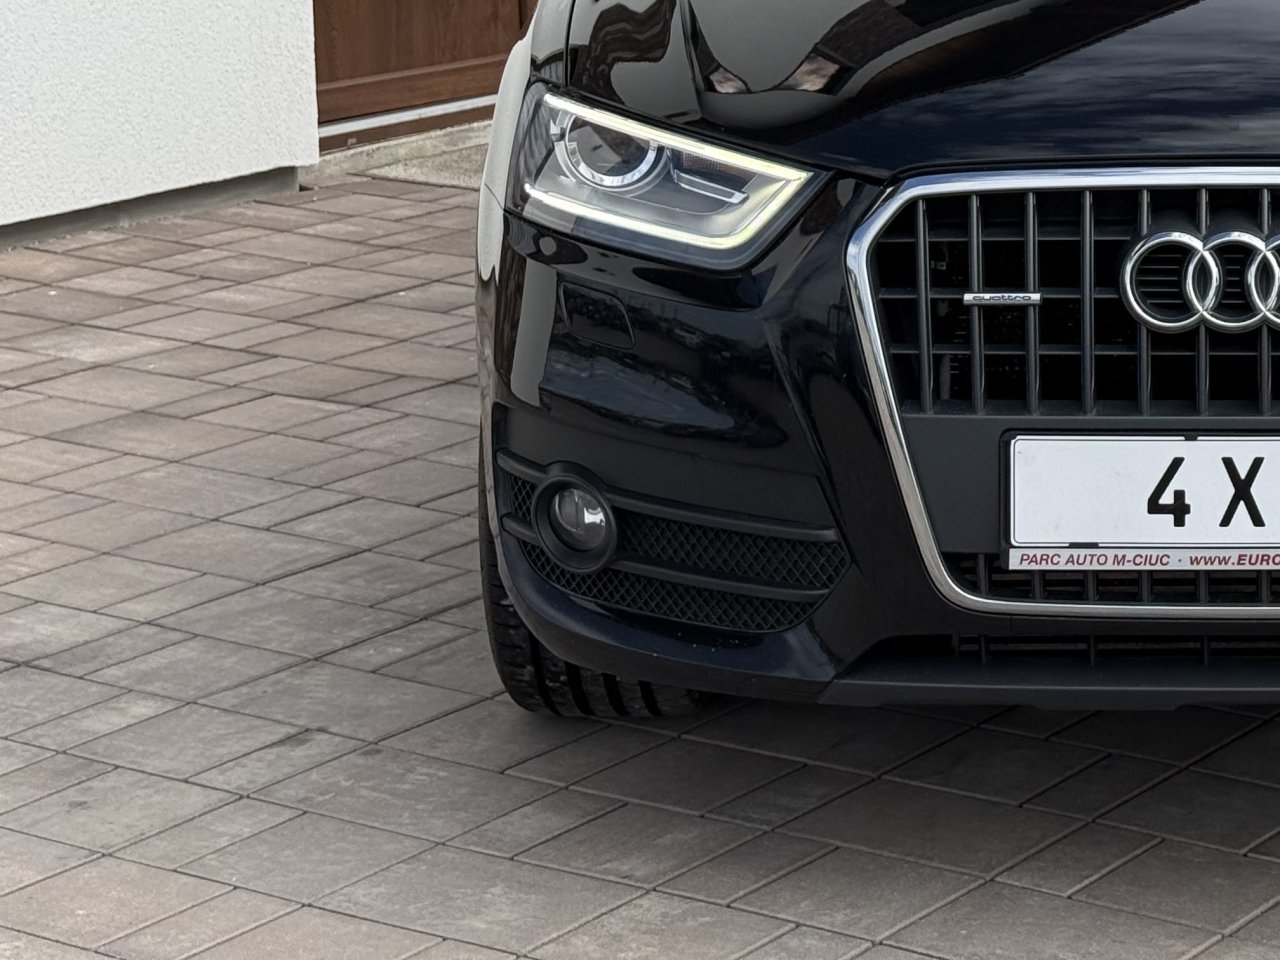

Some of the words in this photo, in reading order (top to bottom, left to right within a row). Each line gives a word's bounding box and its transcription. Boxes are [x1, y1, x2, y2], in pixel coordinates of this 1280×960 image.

[972, 294, 1032, 303] quattro
[1147, 456, 1191, 528] 4
[1219, 456, 1266, 528] X
[1019, 553, 1062, 566] PARC
[1065, 553, 1109, 566] AUTO
[1112, 553, 1171, 567] M-CIUC
